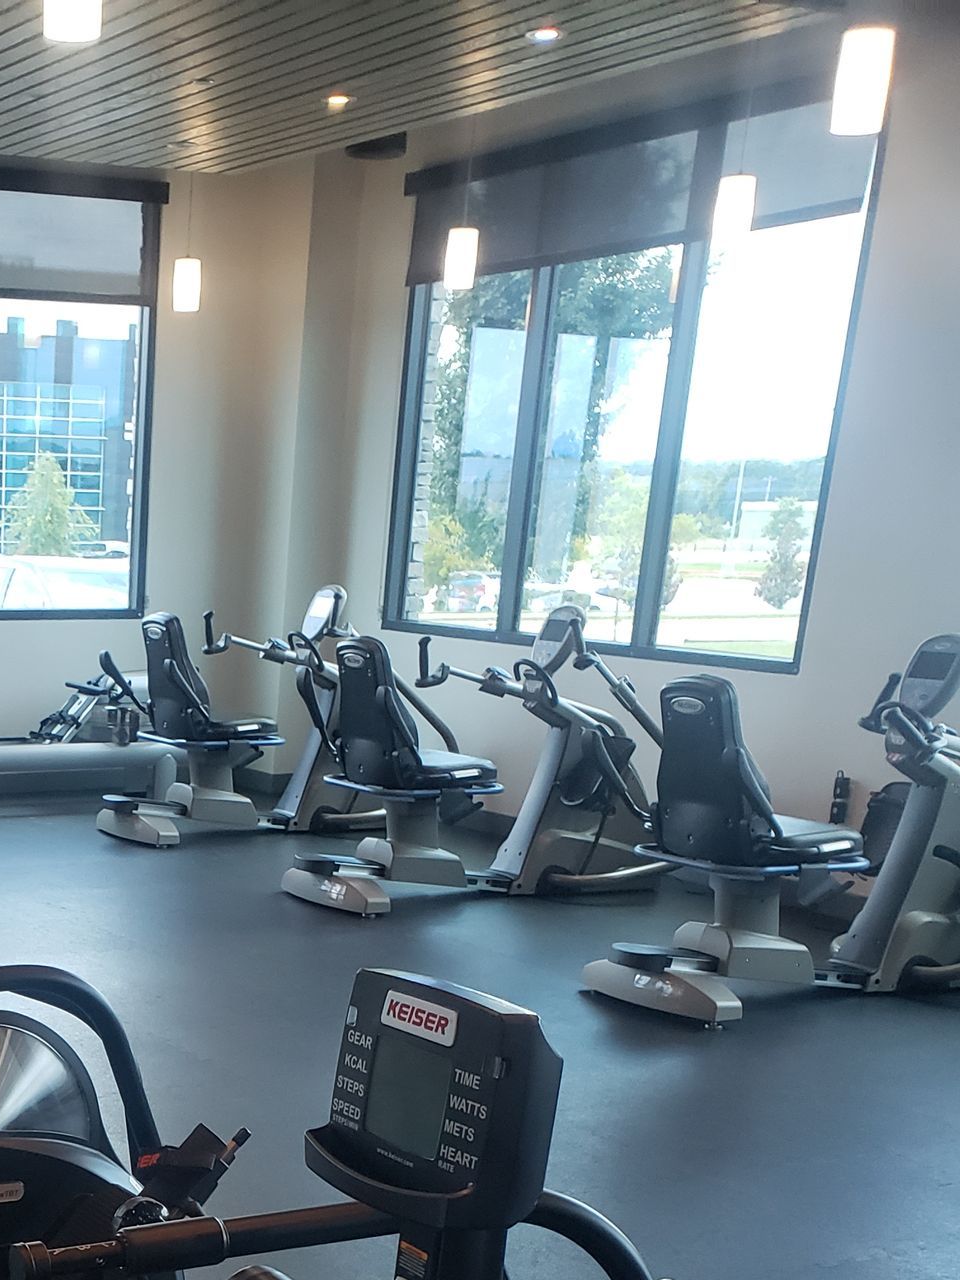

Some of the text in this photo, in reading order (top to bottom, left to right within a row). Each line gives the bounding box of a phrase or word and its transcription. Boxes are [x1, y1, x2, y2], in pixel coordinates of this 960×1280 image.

[386, 999, 449, 1035] KEISER
[347, 1029, 373, 1050] GEAR
[344, 1053, 368, 1074] KCAL
[336, 1075, 365, 1097] STEPS
[454, 1068, 481, 1090] TIME
[332, 1098, 361, 1120] SPEED
[449, 1094, 488, 1120] WATTS
[443, 1118, 475, 1142] METS
[437, 1160, 455, 1173] RATE
[439, 1144, 479, 1170] HEART
